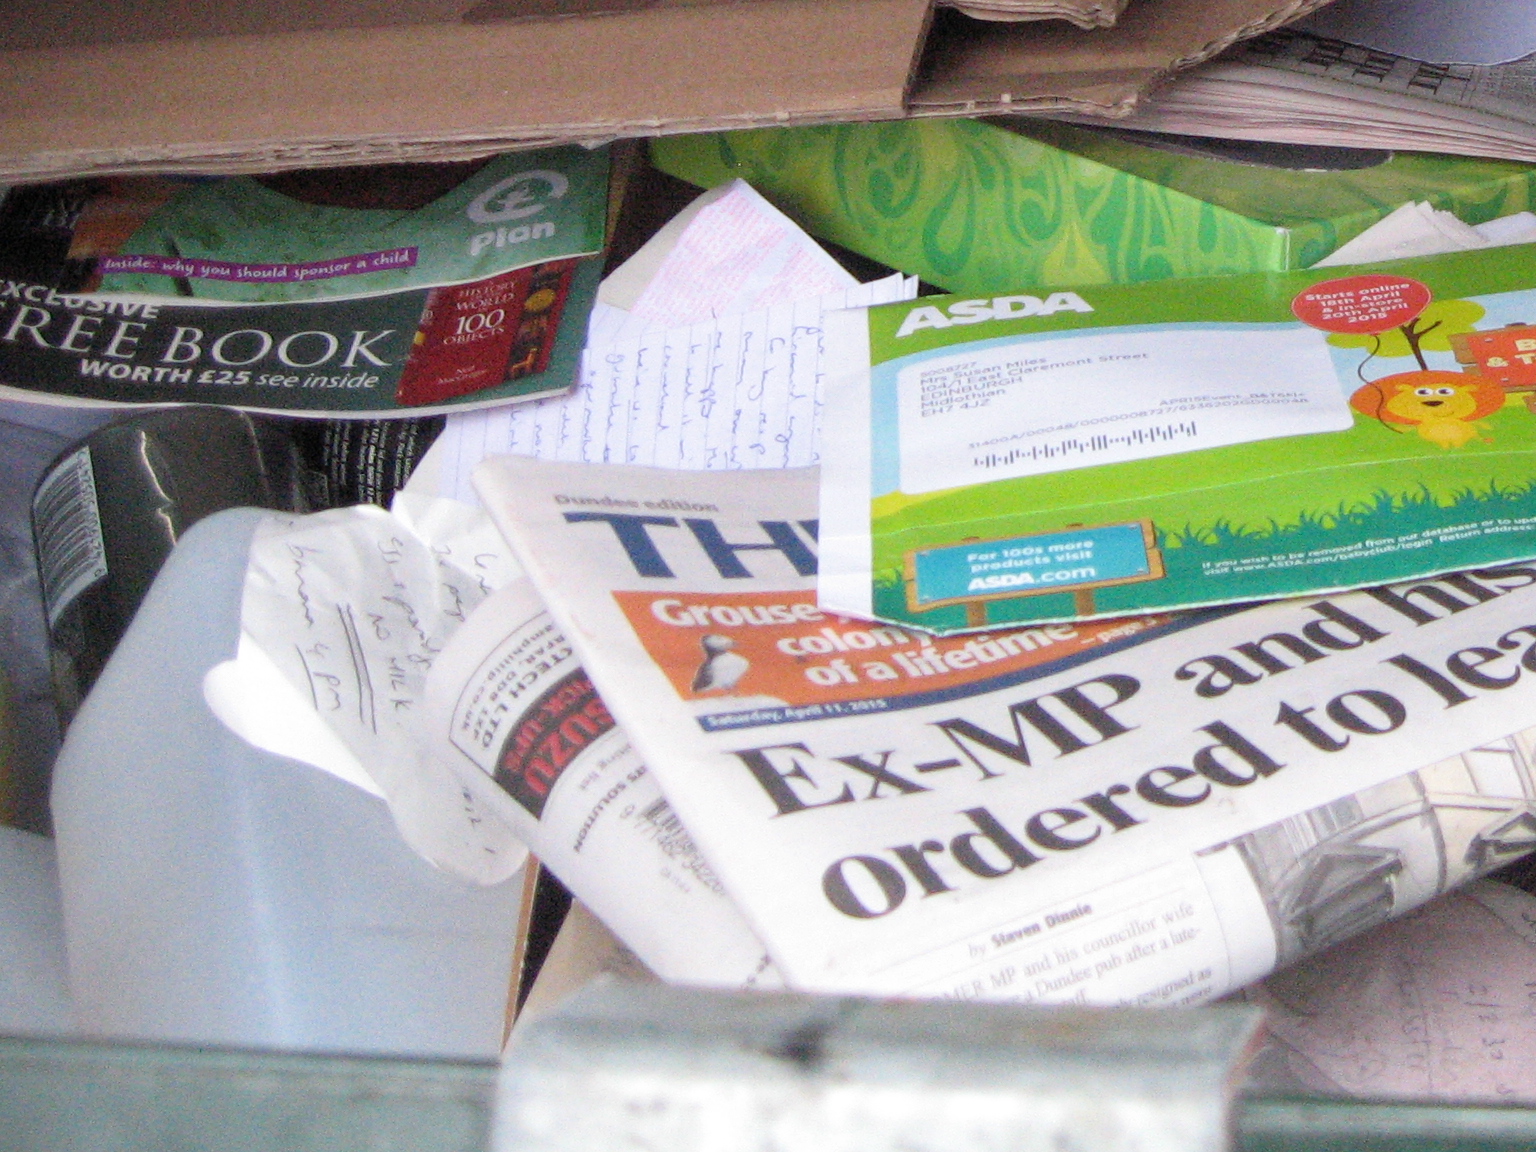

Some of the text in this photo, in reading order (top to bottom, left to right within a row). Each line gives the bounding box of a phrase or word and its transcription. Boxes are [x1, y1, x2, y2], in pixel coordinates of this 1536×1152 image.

[470, 219, 556, 255] Plan
[104, 249, 410, 281] Inside: why you should sponsor child
[0, 279, 164, 320] XCLUSIVE
[1305, 283, 1410, 301] Starts online
[1339, 297, 1403, 310] in-store
[1360, 291, 1401, 302] April
[456, 308, 506, 335] 100
[895, 291, 1096, 338] ASDA
[1368, 303, 1409, 314] April
[0, 302, 397, 369] REE BOOK
[1098, 351, 1150, 364] Street
[1486, 356, 1509, 368] &
[80, 358, 381, 390] WORTH £25 see inside
[920, 376, 1024, 401] EDINBURGH
[554, 493, 719, 513] Dundee edition
[562, 512, 820, 579] TH
[967, 540, 1094, 562] For 100s more
[1308, 542, 1364, 558] removed
[1421, 522, 1479, 539] database
[970, 550, 1093, 574] products visit
[968, 567, 1097, 591] ASDA.com
[651, 598, 823, 628] Grouse
[805, 624, 1079, 687] of a lifetime
[708, 709, 783, 727] Saturday,
[729, 673, 1141, 818] Ex-MP
[1175, 600, 1391, 699] and
[481, 702, 510, 750] LTD
[504, 677, 595, 774] ICK-UPS
[573, 782, 627, 854] SOLUTION
[821, 719, 1288, 920] ordered
[1275, 689, 1407, 753] to
[991, 902, 1093, 948] Steven Dinnie
[1082, 901, 1195, 956] councillor wife
[1035, 937, 1158, 997] Dundee pub after
